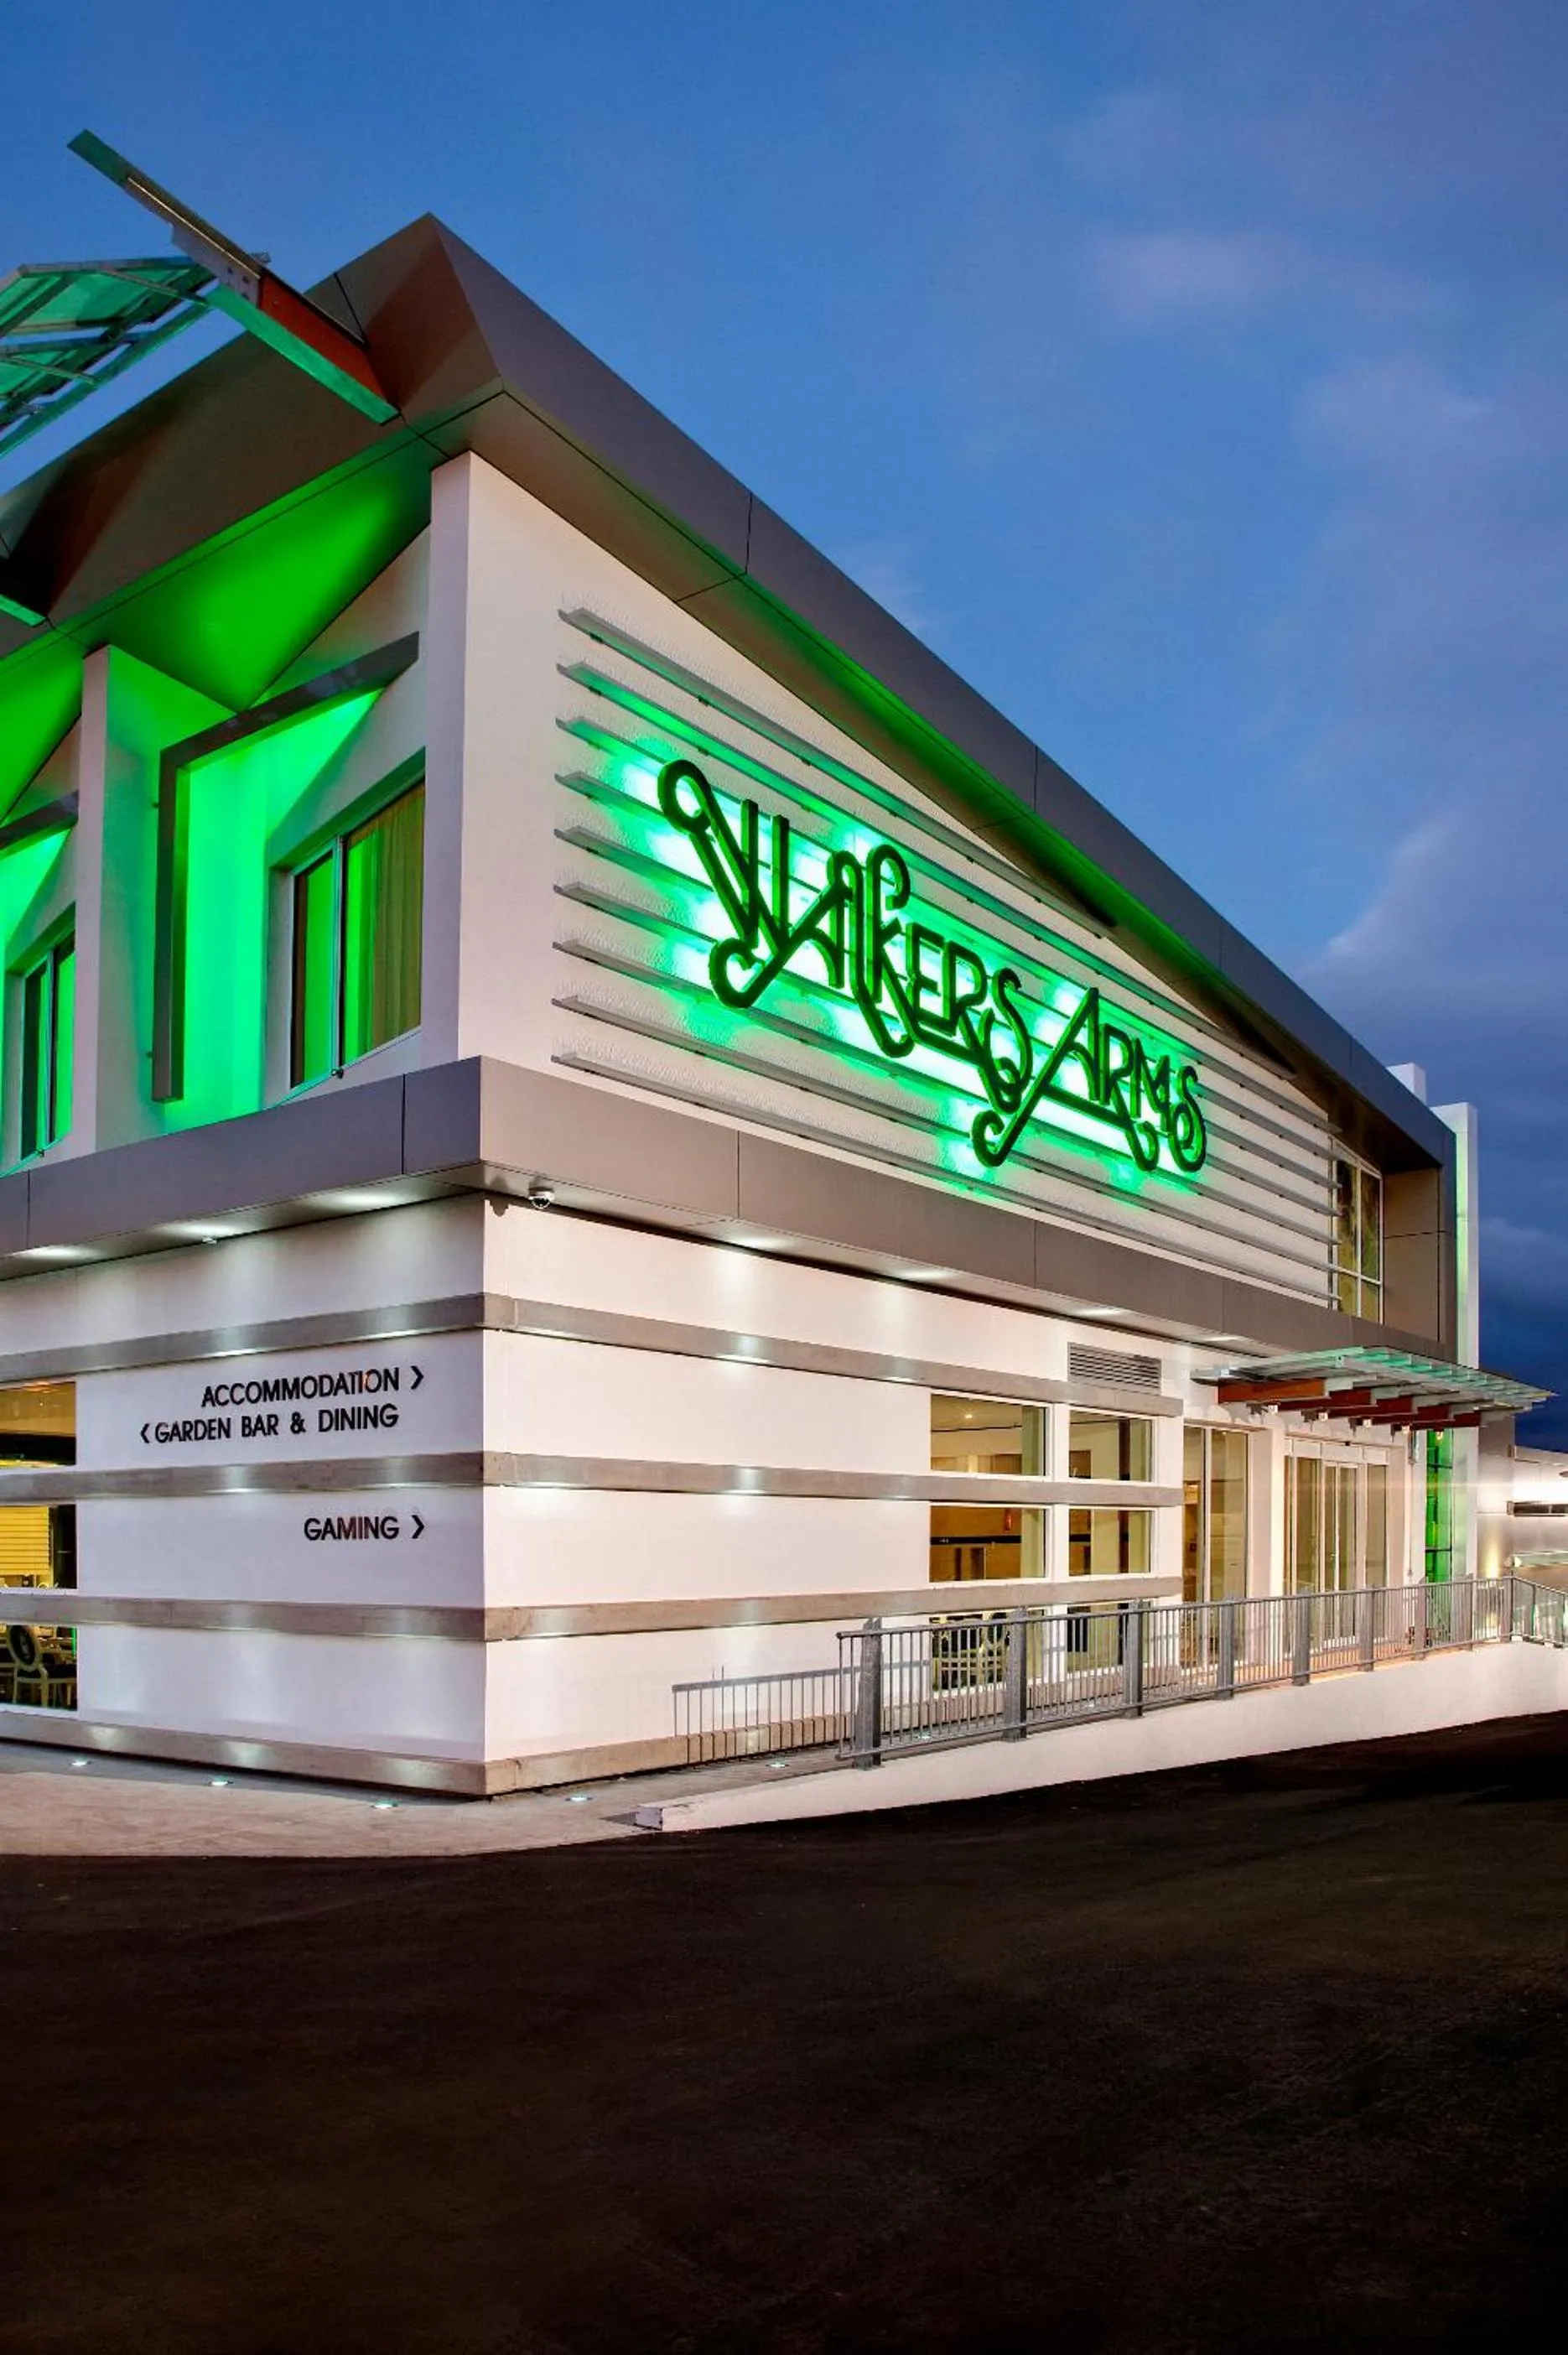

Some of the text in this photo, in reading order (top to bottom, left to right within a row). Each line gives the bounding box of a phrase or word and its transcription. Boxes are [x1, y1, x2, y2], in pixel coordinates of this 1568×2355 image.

[657, 759, 1207, 1172] WALKERS ARMS
[201, 1368, 400, 1407] ACCOMMODATION
[154, 1404, 399, 1443] GARDEN BAR & DINING
[304, 1515, 400, 1540] GAMING
